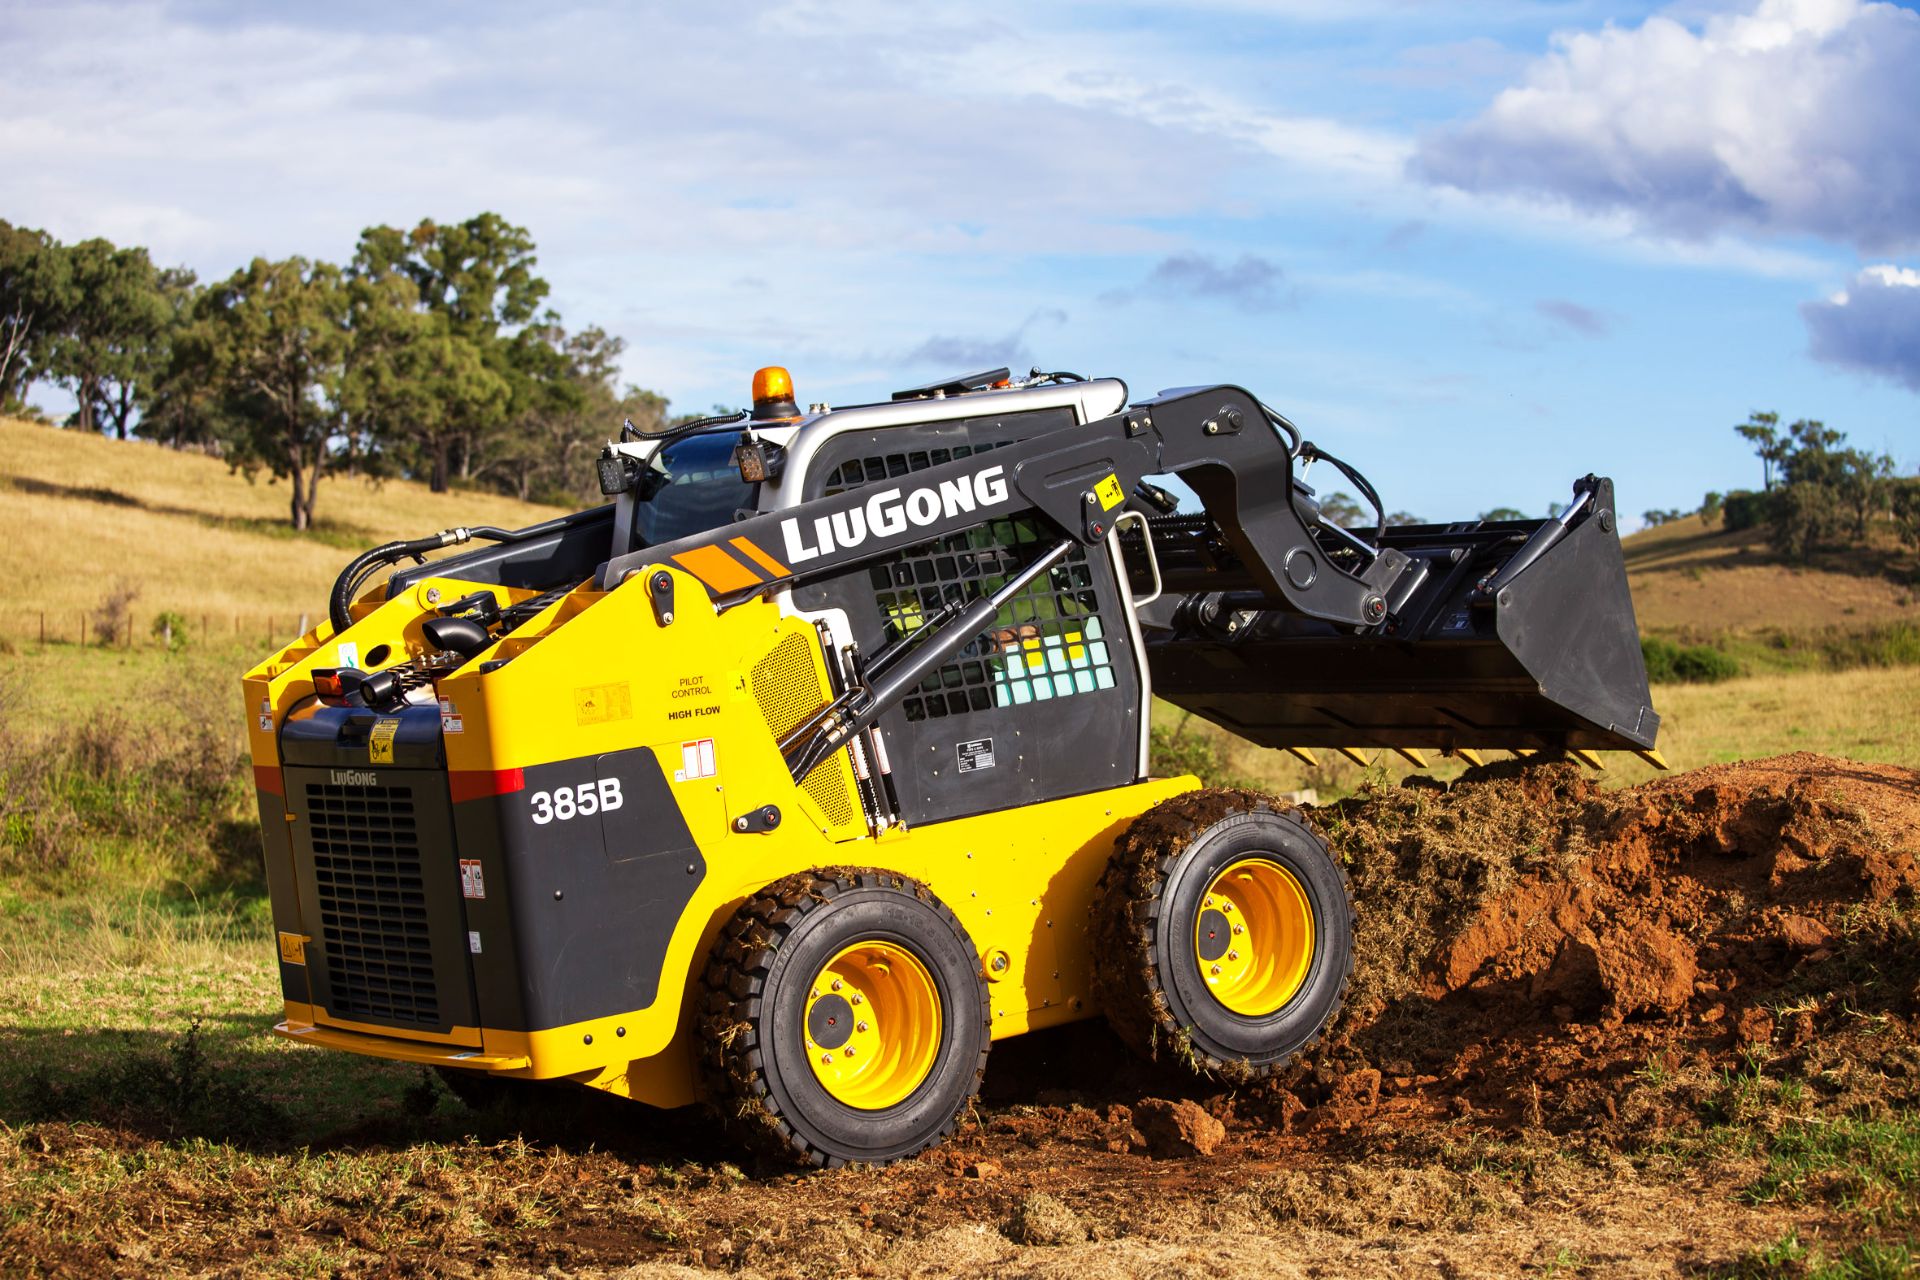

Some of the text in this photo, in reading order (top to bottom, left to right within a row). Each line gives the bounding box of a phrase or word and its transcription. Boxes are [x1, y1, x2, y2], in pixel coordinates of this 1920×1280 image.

[780, 465, 1009, 564] LIUGONG
[679, 676, 704, 686] PILOT
[671, 686, 712, 699] CONTROL
[668, 705, 721, 720] HIGH FLOW
[530, 777, 624, 825] 385B
